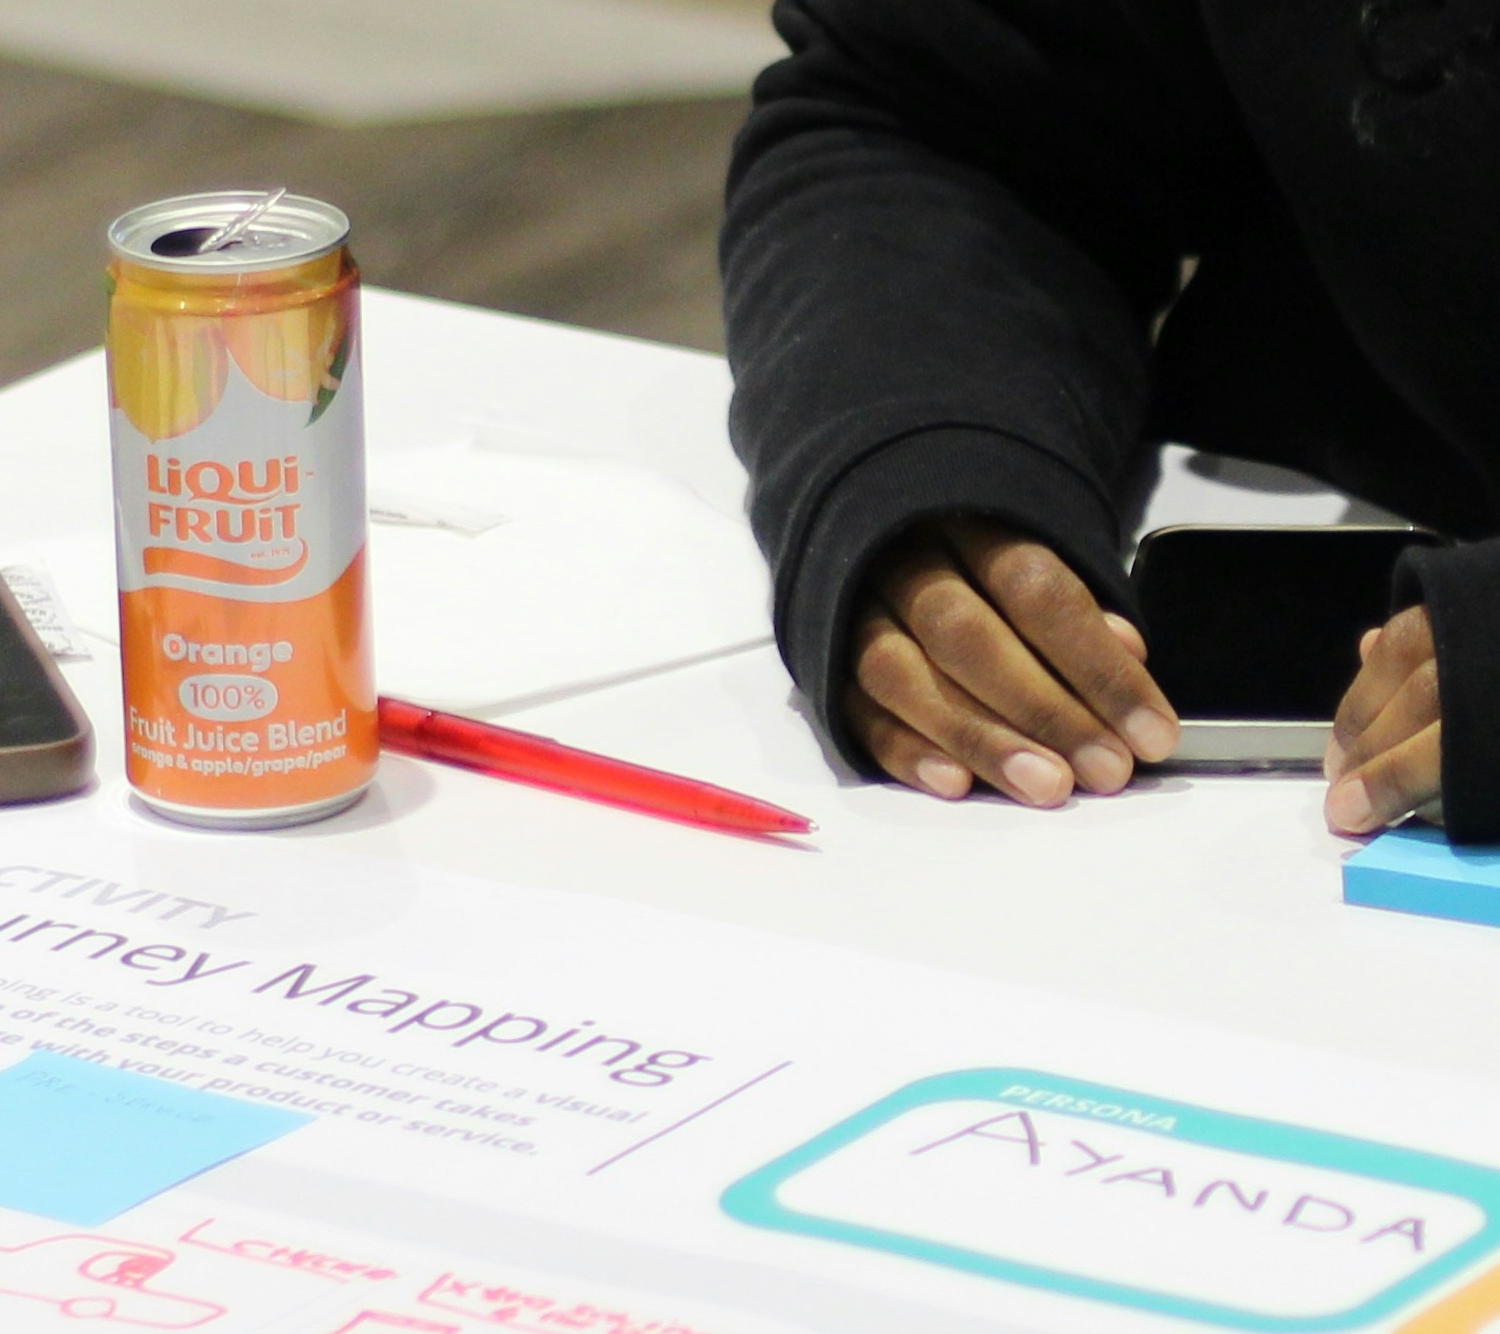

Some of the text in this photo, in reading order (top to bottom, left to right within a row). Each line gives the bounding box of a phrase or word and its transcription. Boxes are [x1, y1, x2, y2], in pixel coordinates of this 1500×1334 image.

[163, 632, 293, 673] Orange
[129, 704, 348, 753] Fruit Juice Blend
[189, 682, 266, 710] 100%
[131, 741, 348, 777] orange & apple/grape/pear
[59, 990, 95, 1008] is
[94, 1001, 121, 1013] a
[123, 1005, 201, 1027] tool
[196, 1018, 235, 1036] to
[236, 1026, 316, 1055] help
[309, 1046, 388, 1070] you
[389, 1062, 501, 1093] create
[501, 1086, 529, 1100] a
[534, 1091, 653, 1124] visual
[252, 962, 715, 1088] Mapping
[8, 1008, 62, 1024] of
[52, 1016, 118, 1038] the
[119, 1031, 221, 1059] steps
[221, 1053, 251, 1066] a
[253, 1060, 433, 1105] customer
[431, 1097, 539, 1128] takes
[29, 1037, 111, 1065] with
[116, 1056, 205, 1082] your
[199, 1076, 354, 1116] product
[355, 1109, 404, 1126] or
[400, 1118, 540, 1156] service.
[1002, 1083, 1179, 1135] PERSONA
[907, 1109, 1426, 1255] AYANDA
